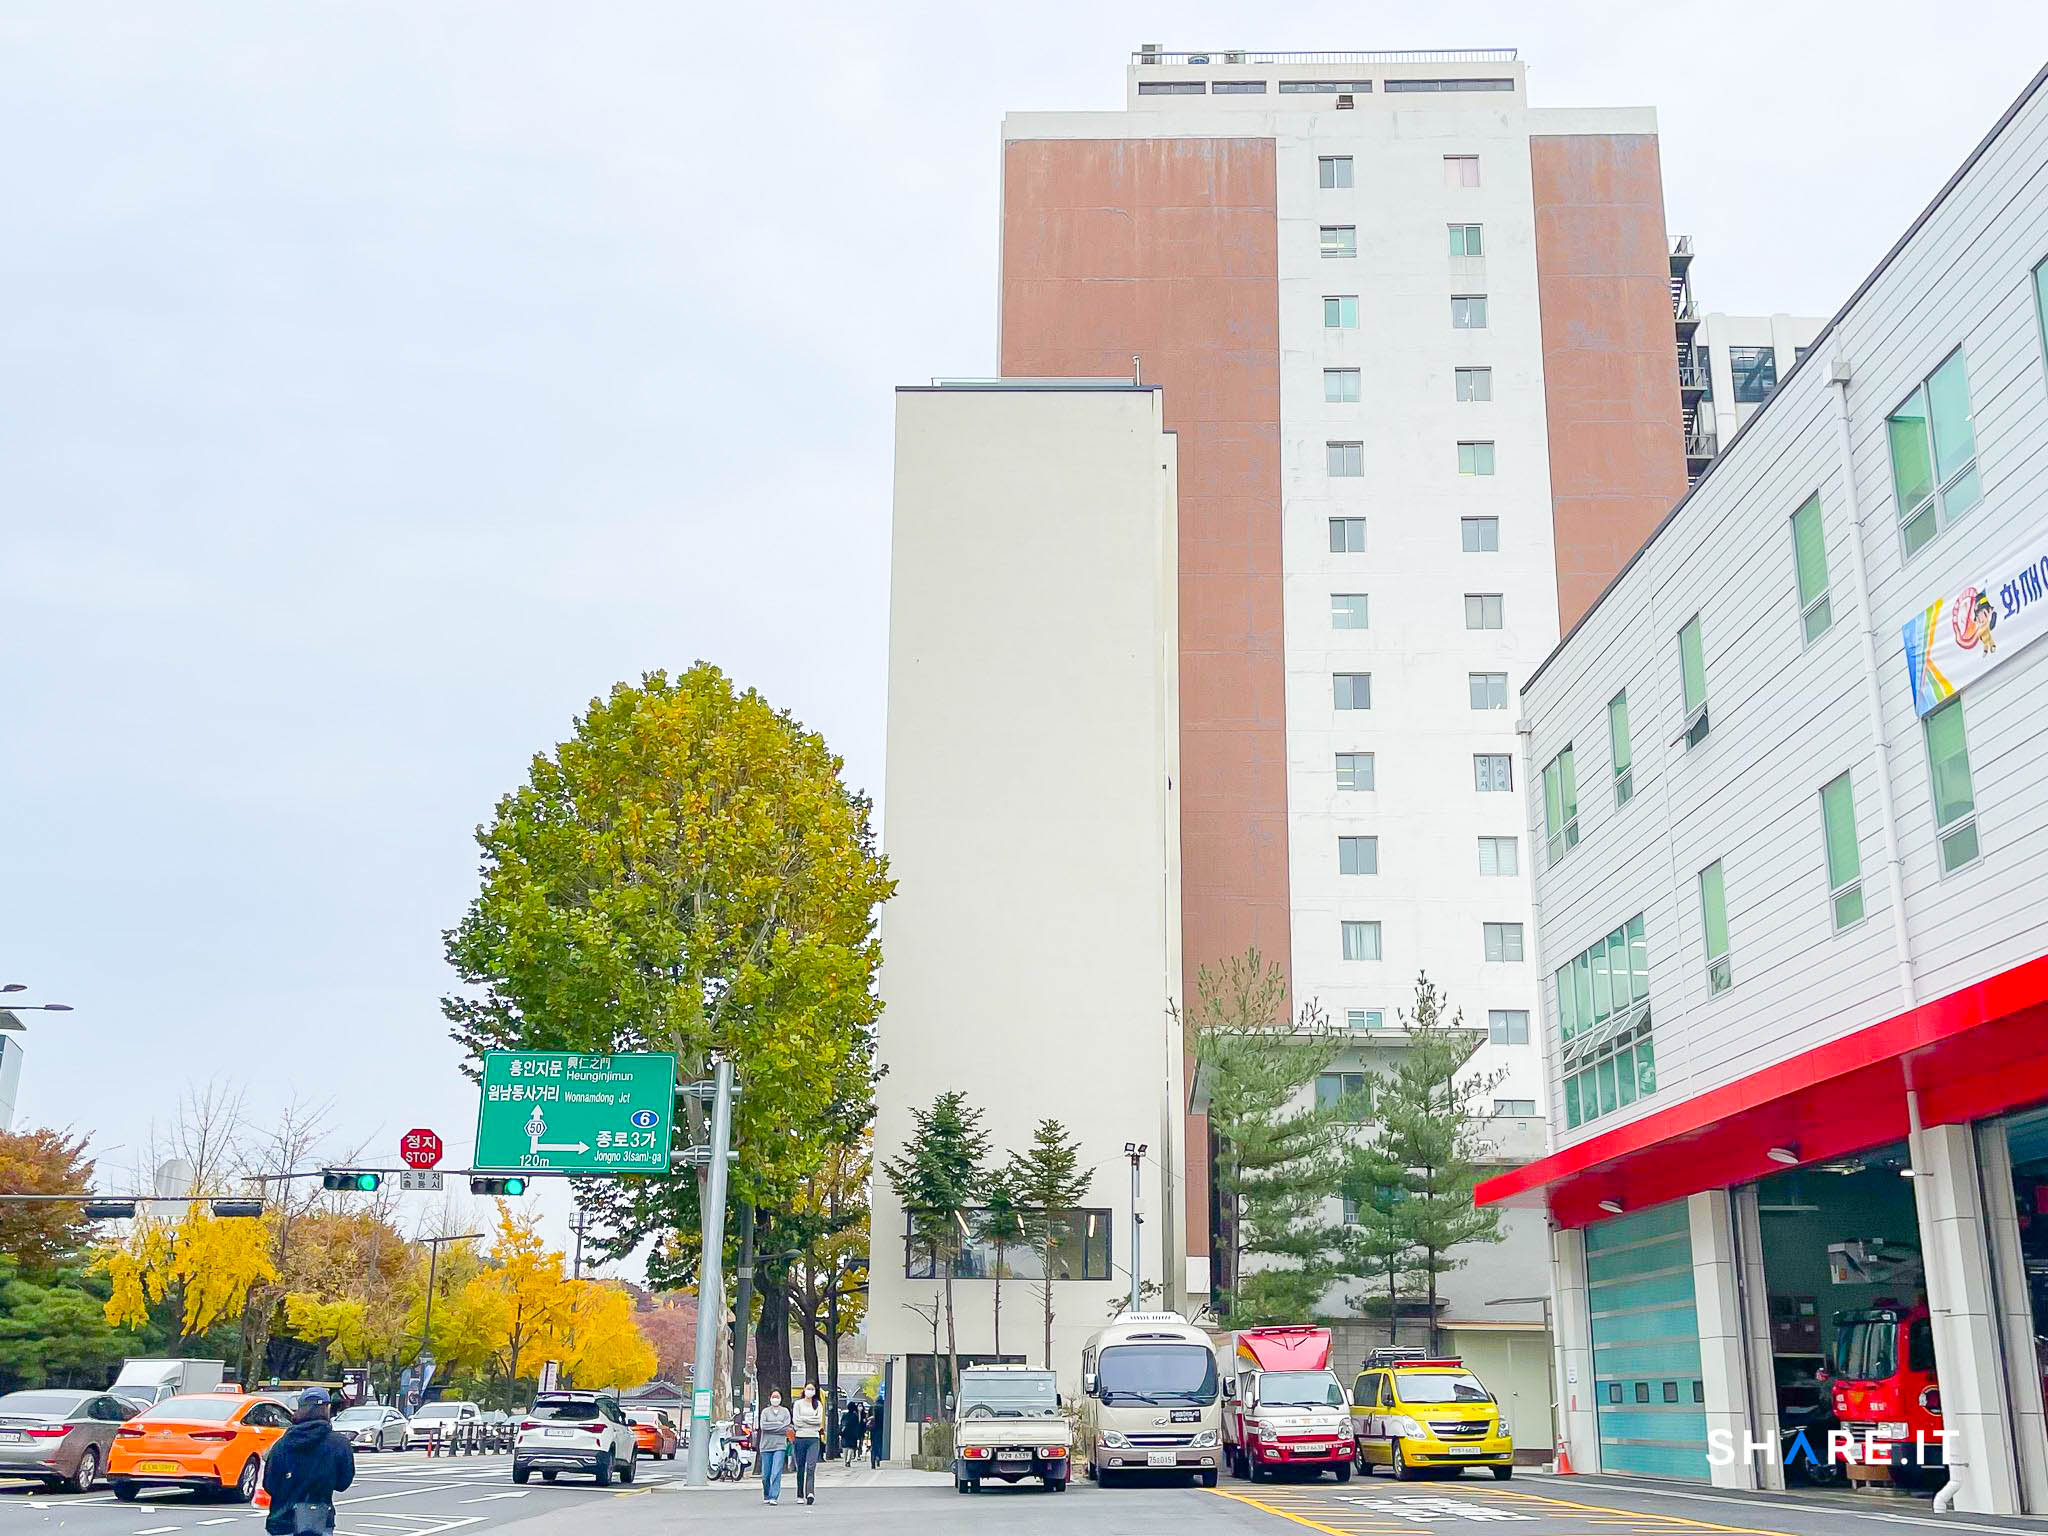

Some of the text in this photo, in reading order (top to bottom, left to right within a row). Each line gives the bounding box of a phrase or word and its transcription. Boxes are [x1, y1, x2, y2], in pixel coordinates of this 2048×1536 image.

[509, 1060, 563, 1077] 흥인지문
[567, 1056, 611, 1070] 興仁之門
[566, 1070, 634, 1083] Heunginjimun
[487, 1084, 560, 1102] 원남동사거리
[564, 1091, 631, 1106] Wonnamdong Jct
[640, 1112, 651, 1126] 6
[529, 1122, 542, 1134] 50
[406, 1135, 436, 1150] 정지
[595, 1130, 657, 1149] 종로3가
[405, 1151, 436, 1163] STOP
[519, 1154, 550, 1168] 120m
[594, 1149, 621, 1164] Jongno
[403, 1171, 441, 1180] 소방차
